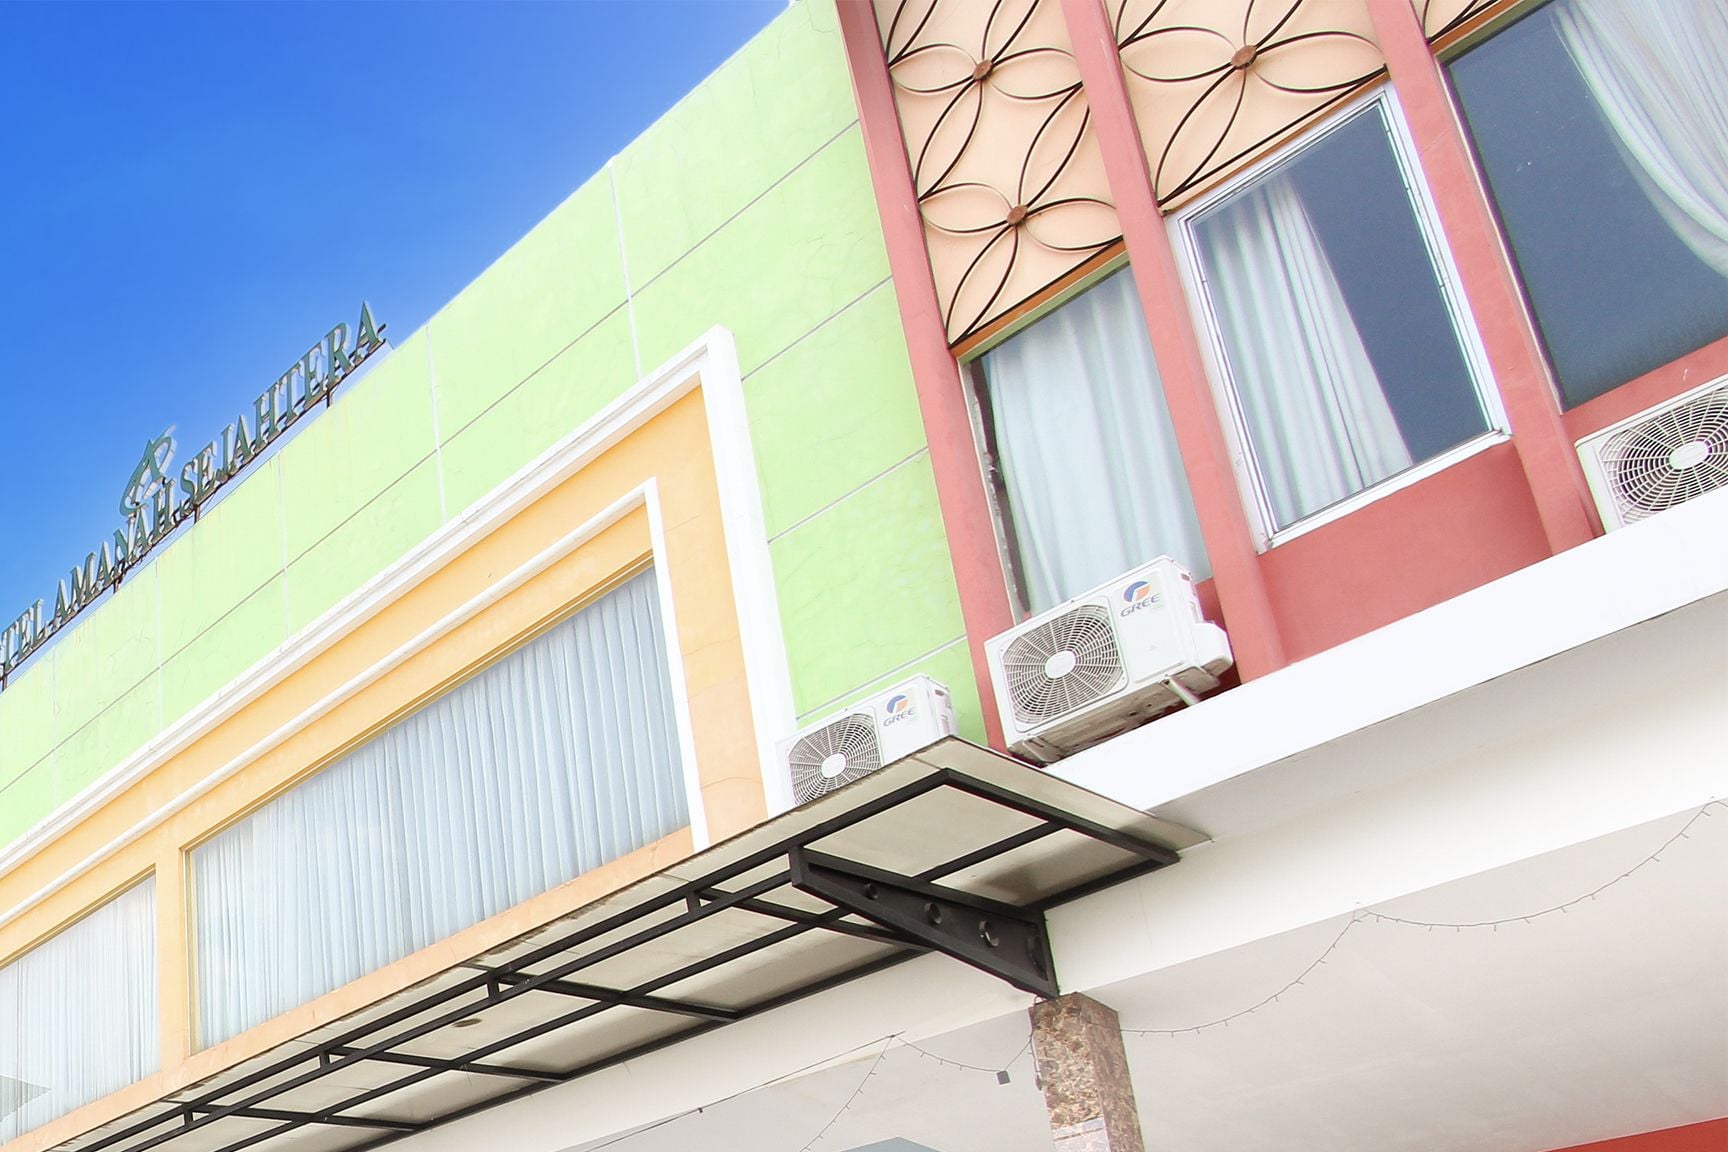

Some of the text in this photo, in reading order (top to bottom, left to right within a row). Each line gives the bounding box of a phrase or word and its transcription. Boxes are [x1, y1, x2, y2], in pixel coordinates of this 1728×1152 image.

[51, 478, 179, 632] AMANAH
[180, 300, 387, 516] SEJAHTERA
[1120, 594, 1160, 618] GREE
[883, 706, 916, 728] GREE
